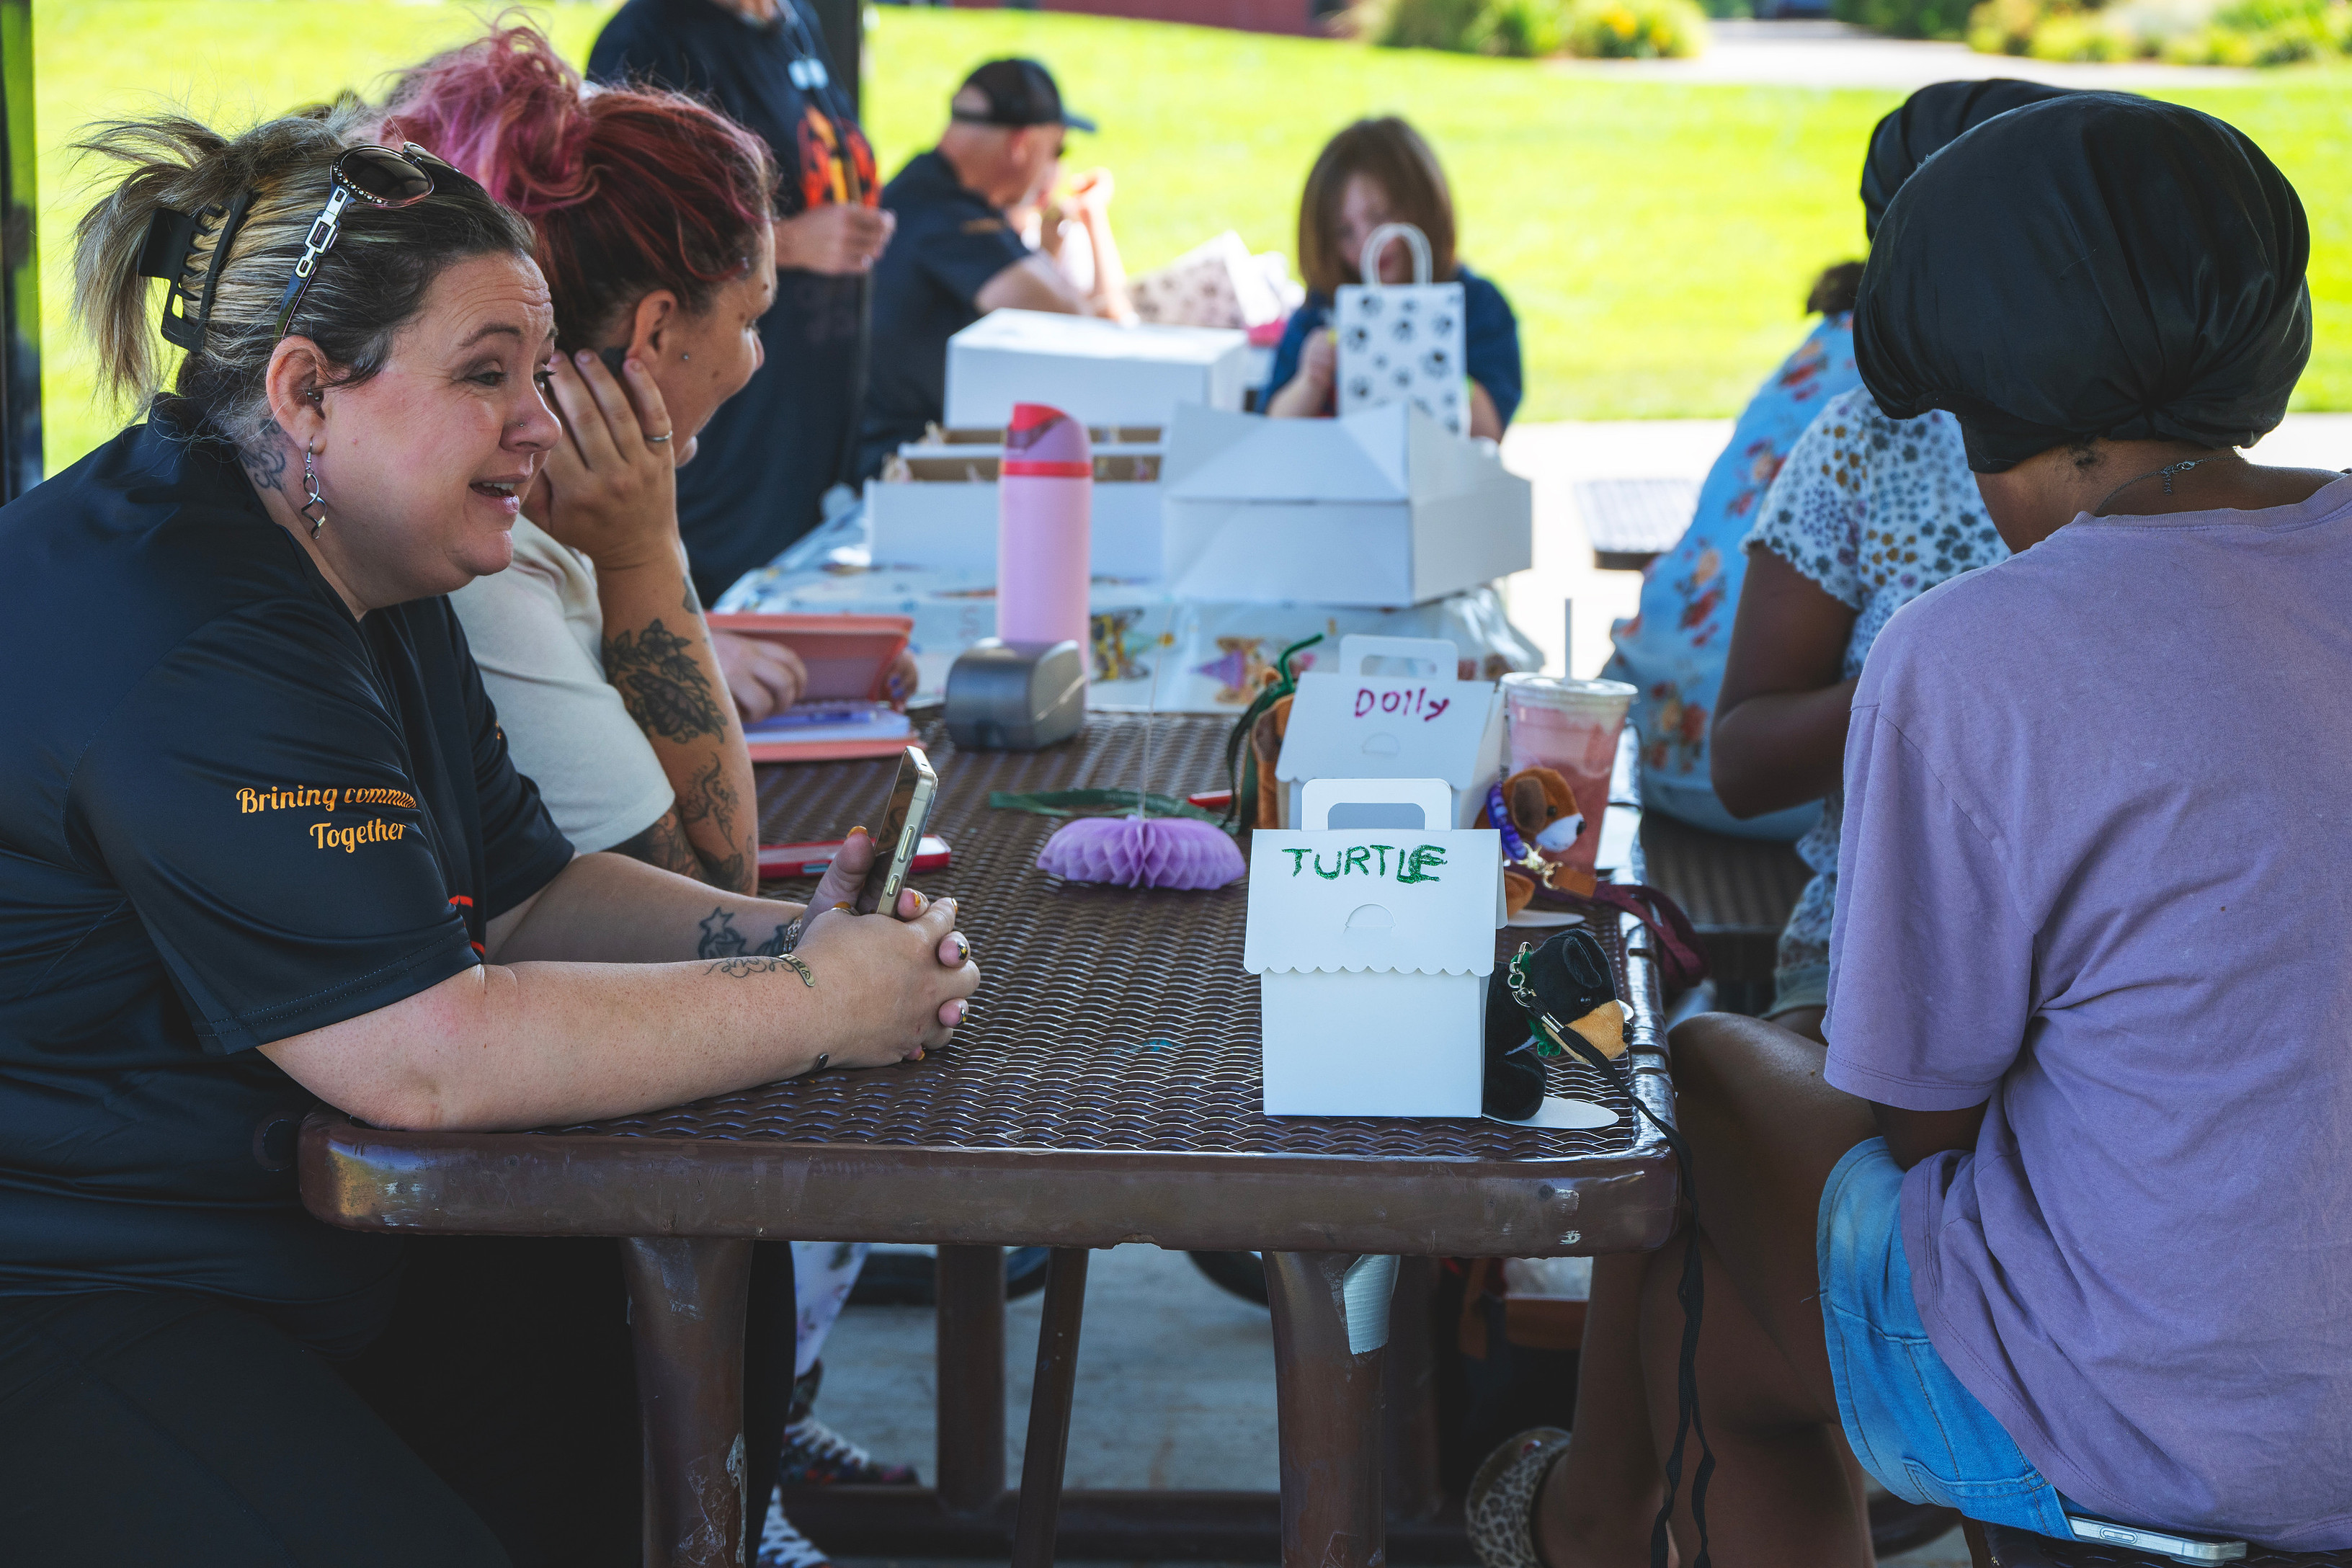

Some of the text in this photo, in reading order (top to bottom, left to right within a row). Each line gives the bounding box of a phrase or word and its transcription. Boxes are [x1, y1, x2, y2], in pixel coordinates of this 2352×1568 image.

[236, 785, 338, 814] Brining
[309, 819, 406, 853] Together
[1281, 844, 1448, 884] TURTLE
